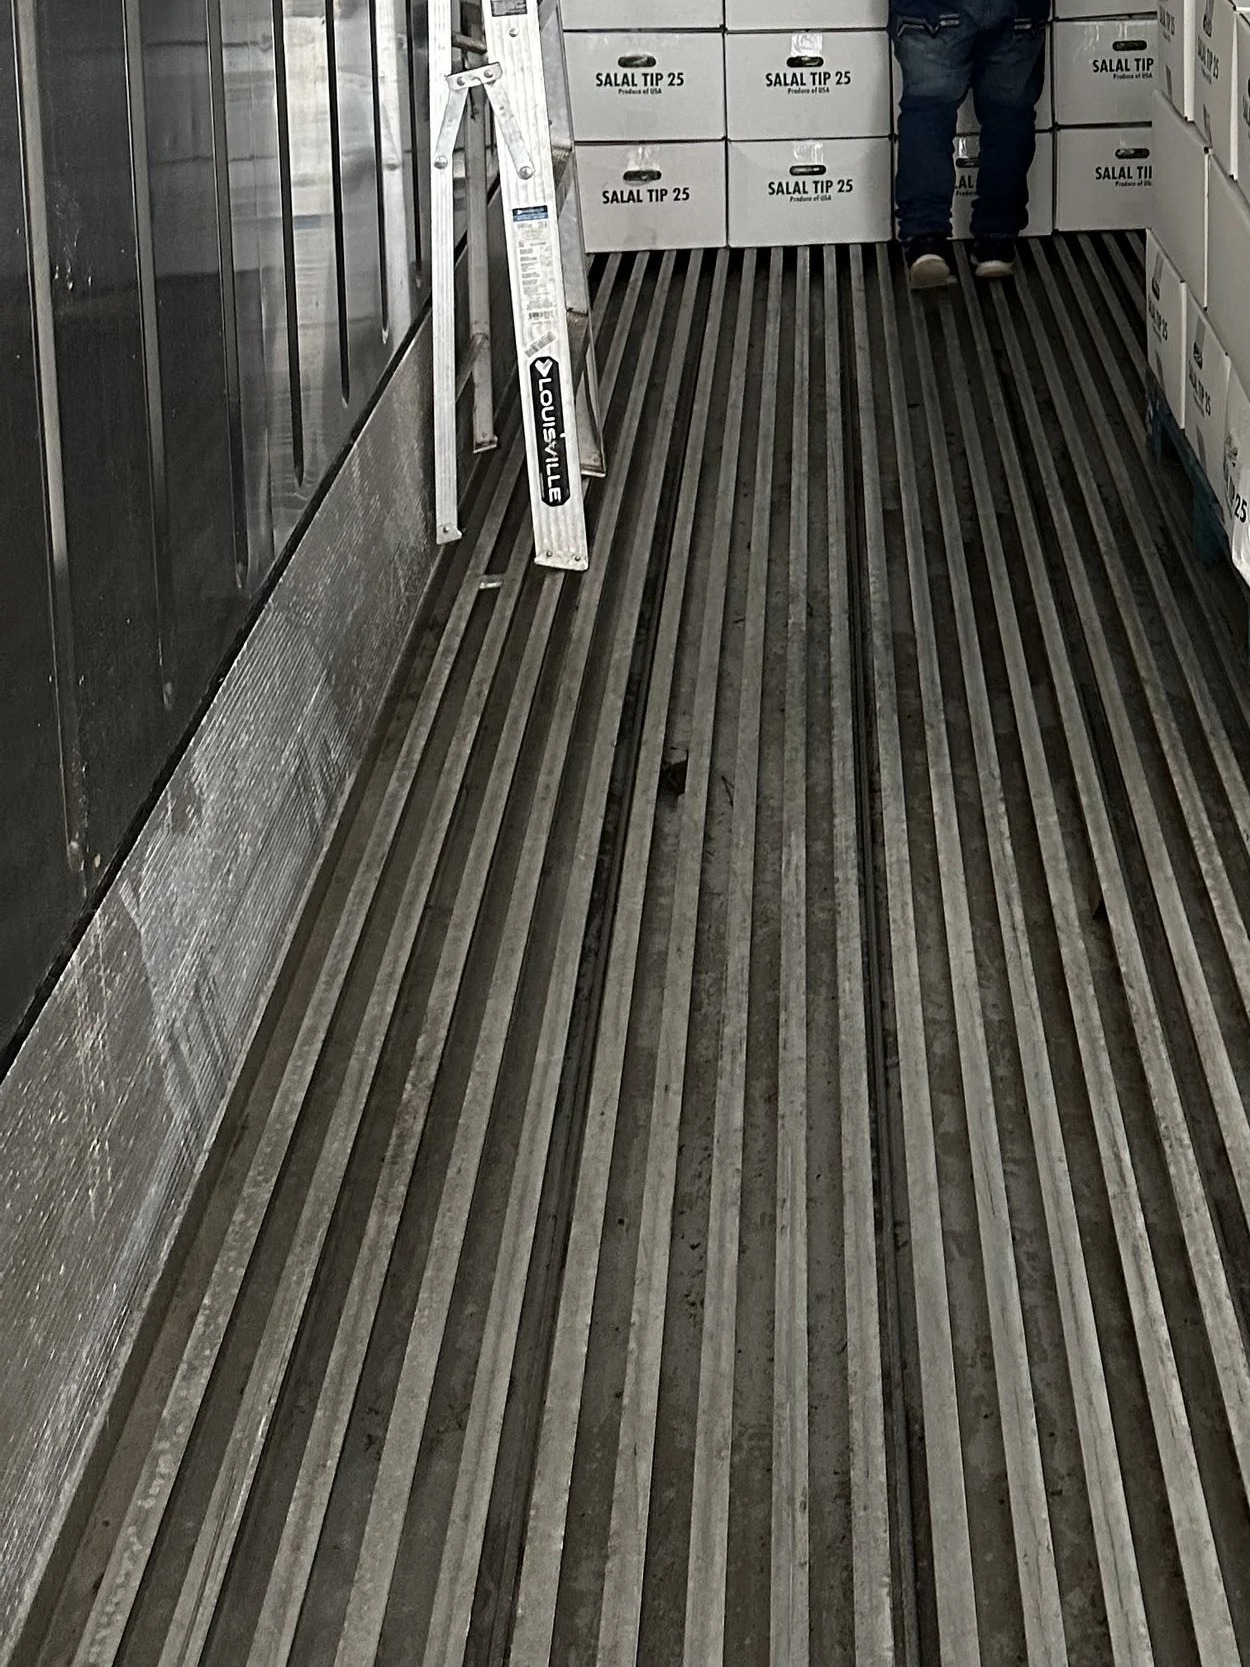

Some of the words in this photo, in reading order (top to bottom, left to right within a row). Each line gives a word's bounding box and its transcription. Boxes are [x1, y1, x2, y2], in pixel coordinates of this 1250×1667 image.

[1092, 58, 1131, 73] SALAL
[1134, 57, 1154, 72] TIP
[595, 72, 638, 87] SALAL
[641, 72, 664, 87] TIP
[667, 72, 684, 87] 25
[765, 72, 807, 87] SALAL
[810, 71, 832, 86] TIP
[835, 70, 851, 86] 25
[1095, 166, 1133, 180] SALAL
[768, 180, 809, 196] SALAL
[812, 180, 834, 194] TIP
[837, 178, 853, 193] 25
[602, 189, 644, 205] SALAL
[646, 188, 668, 203] TIP
[672, 187, 690, 202] 25
[538, 377, 562, 503] LOUISVILLE
[1234, 494, 1248, 523] 25
